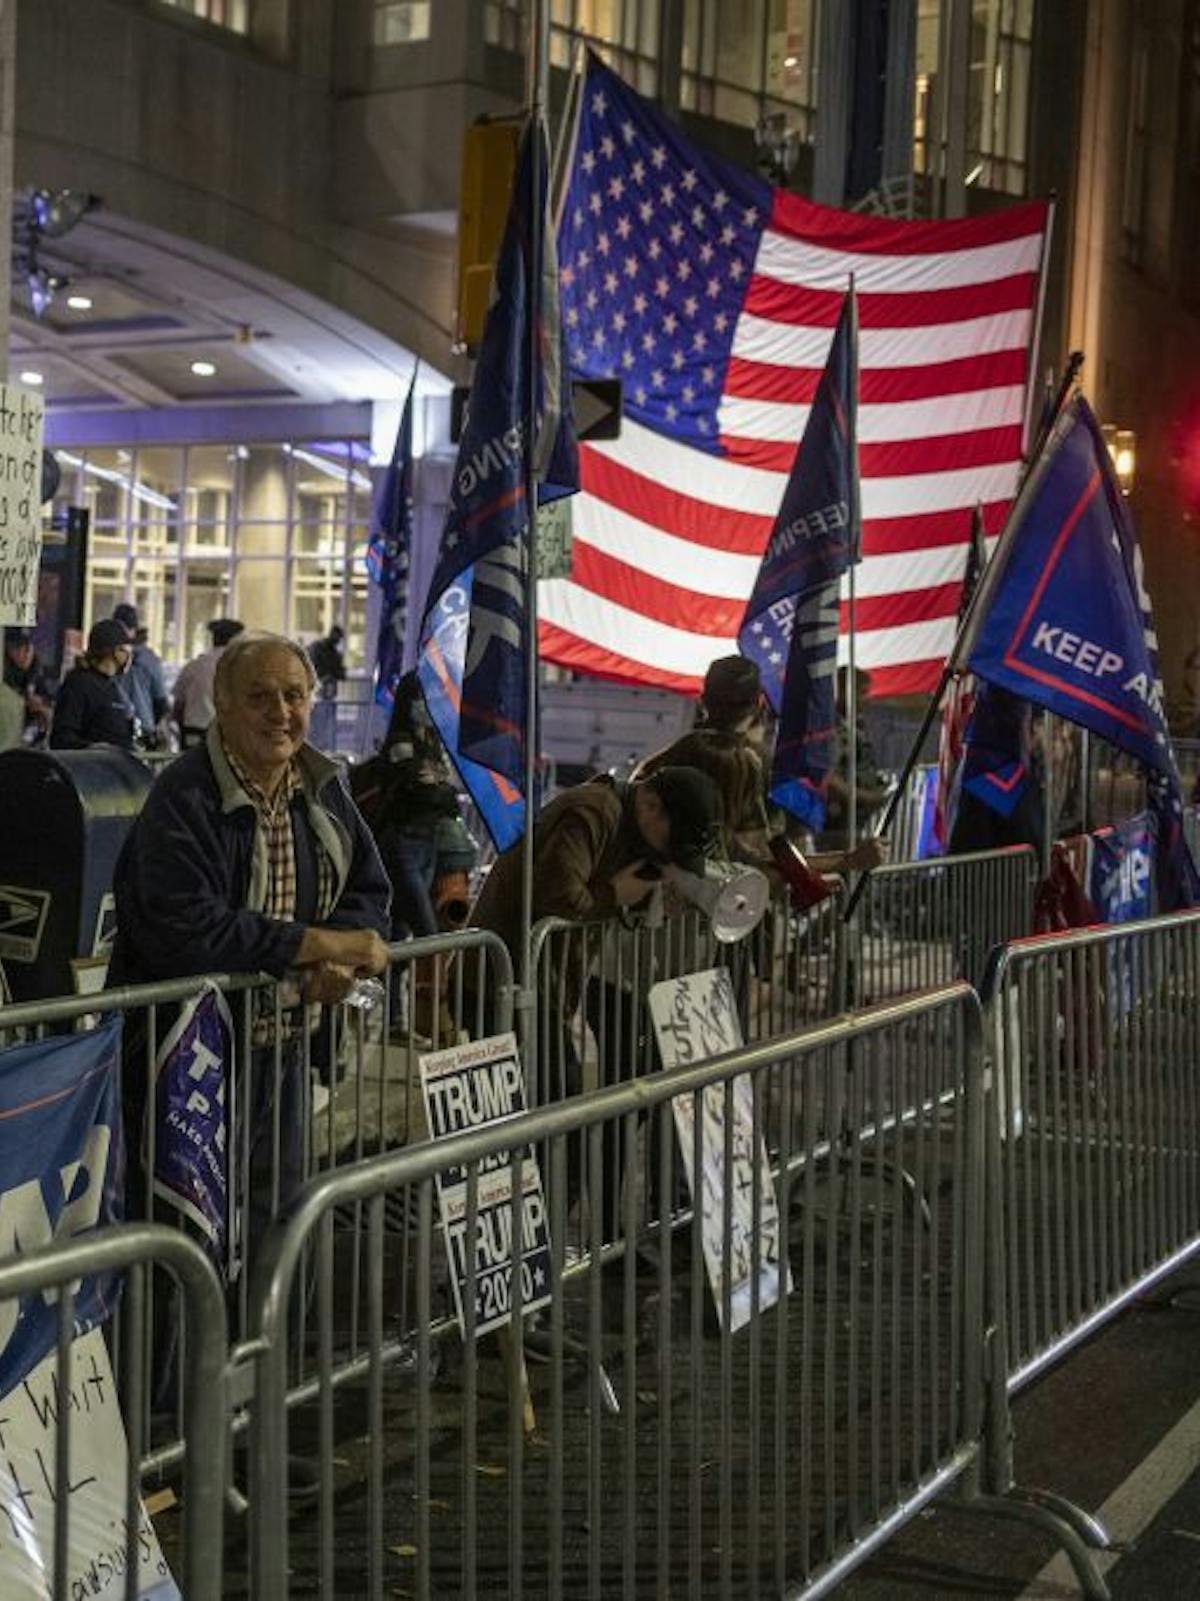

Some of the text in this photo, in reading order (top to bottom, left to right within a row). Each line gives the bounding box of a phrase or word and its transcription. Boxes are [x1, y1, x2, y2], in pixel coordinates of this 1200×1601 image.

[1030, 622, 1124, 680] KEEP
[428, 1060, 520, 1138] TRUMP
[481, 1260, 534, 1319] 200
